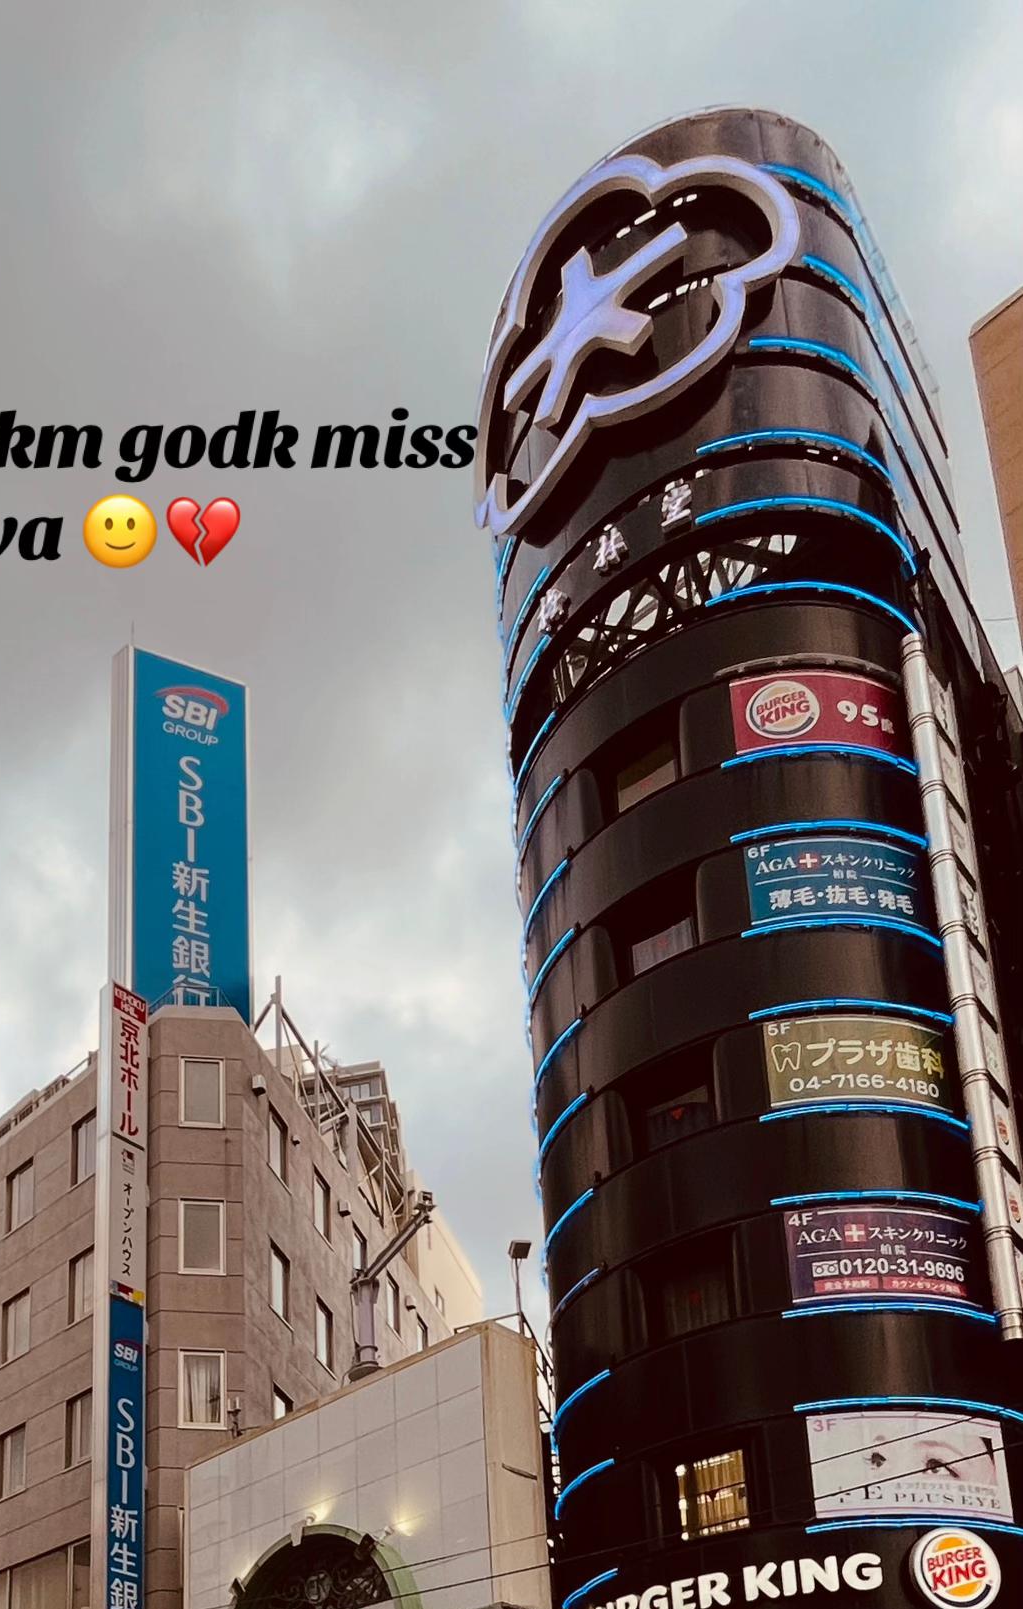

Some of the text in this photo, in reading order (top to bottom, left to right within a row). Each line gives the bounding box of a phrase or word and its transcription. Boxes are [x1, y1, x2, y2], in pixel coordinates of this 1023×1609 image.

[162, 693, 217, 731] SBI
[755, 690, 807, 715] BURGER
[758, 700, 811, 731] KING
[162, 720, 219, 747] GROUP
[747, 845, 771, 859] 6F
[754, 853, 916, 880] AGA スキンクリニック
[172, 755, 210, 1008] SBI新生銀行
[768, 885, 915, 916] 薄毛・抜毛・発毛
[766, 1023, 791, 1037] 5F
[806, 1037, 945, 1080] プラザ歯科
[119, 1016, 141, 1137] 京北ホール
[788, 1073, 940, 1099] 04-7166-4180
[121, 1182, 133, 1277] オープンハウス
[787, 1212, 814, 1227] 4F
[796, 1227, 968, 1250] AGA スキンクリニック
[839, 1257, 965, 1282] 0120-31-9696
[114, 1342, 138, 1365] SBI
[812, 1418, 838, 1434] 3F
[894, 1492, 1002, 1510] PLUS EYE
[927, 1546, 983, 1572] BURGER
[742, 1552, 883, 1602] KING
[930, 1559, 987, 1593] KING
